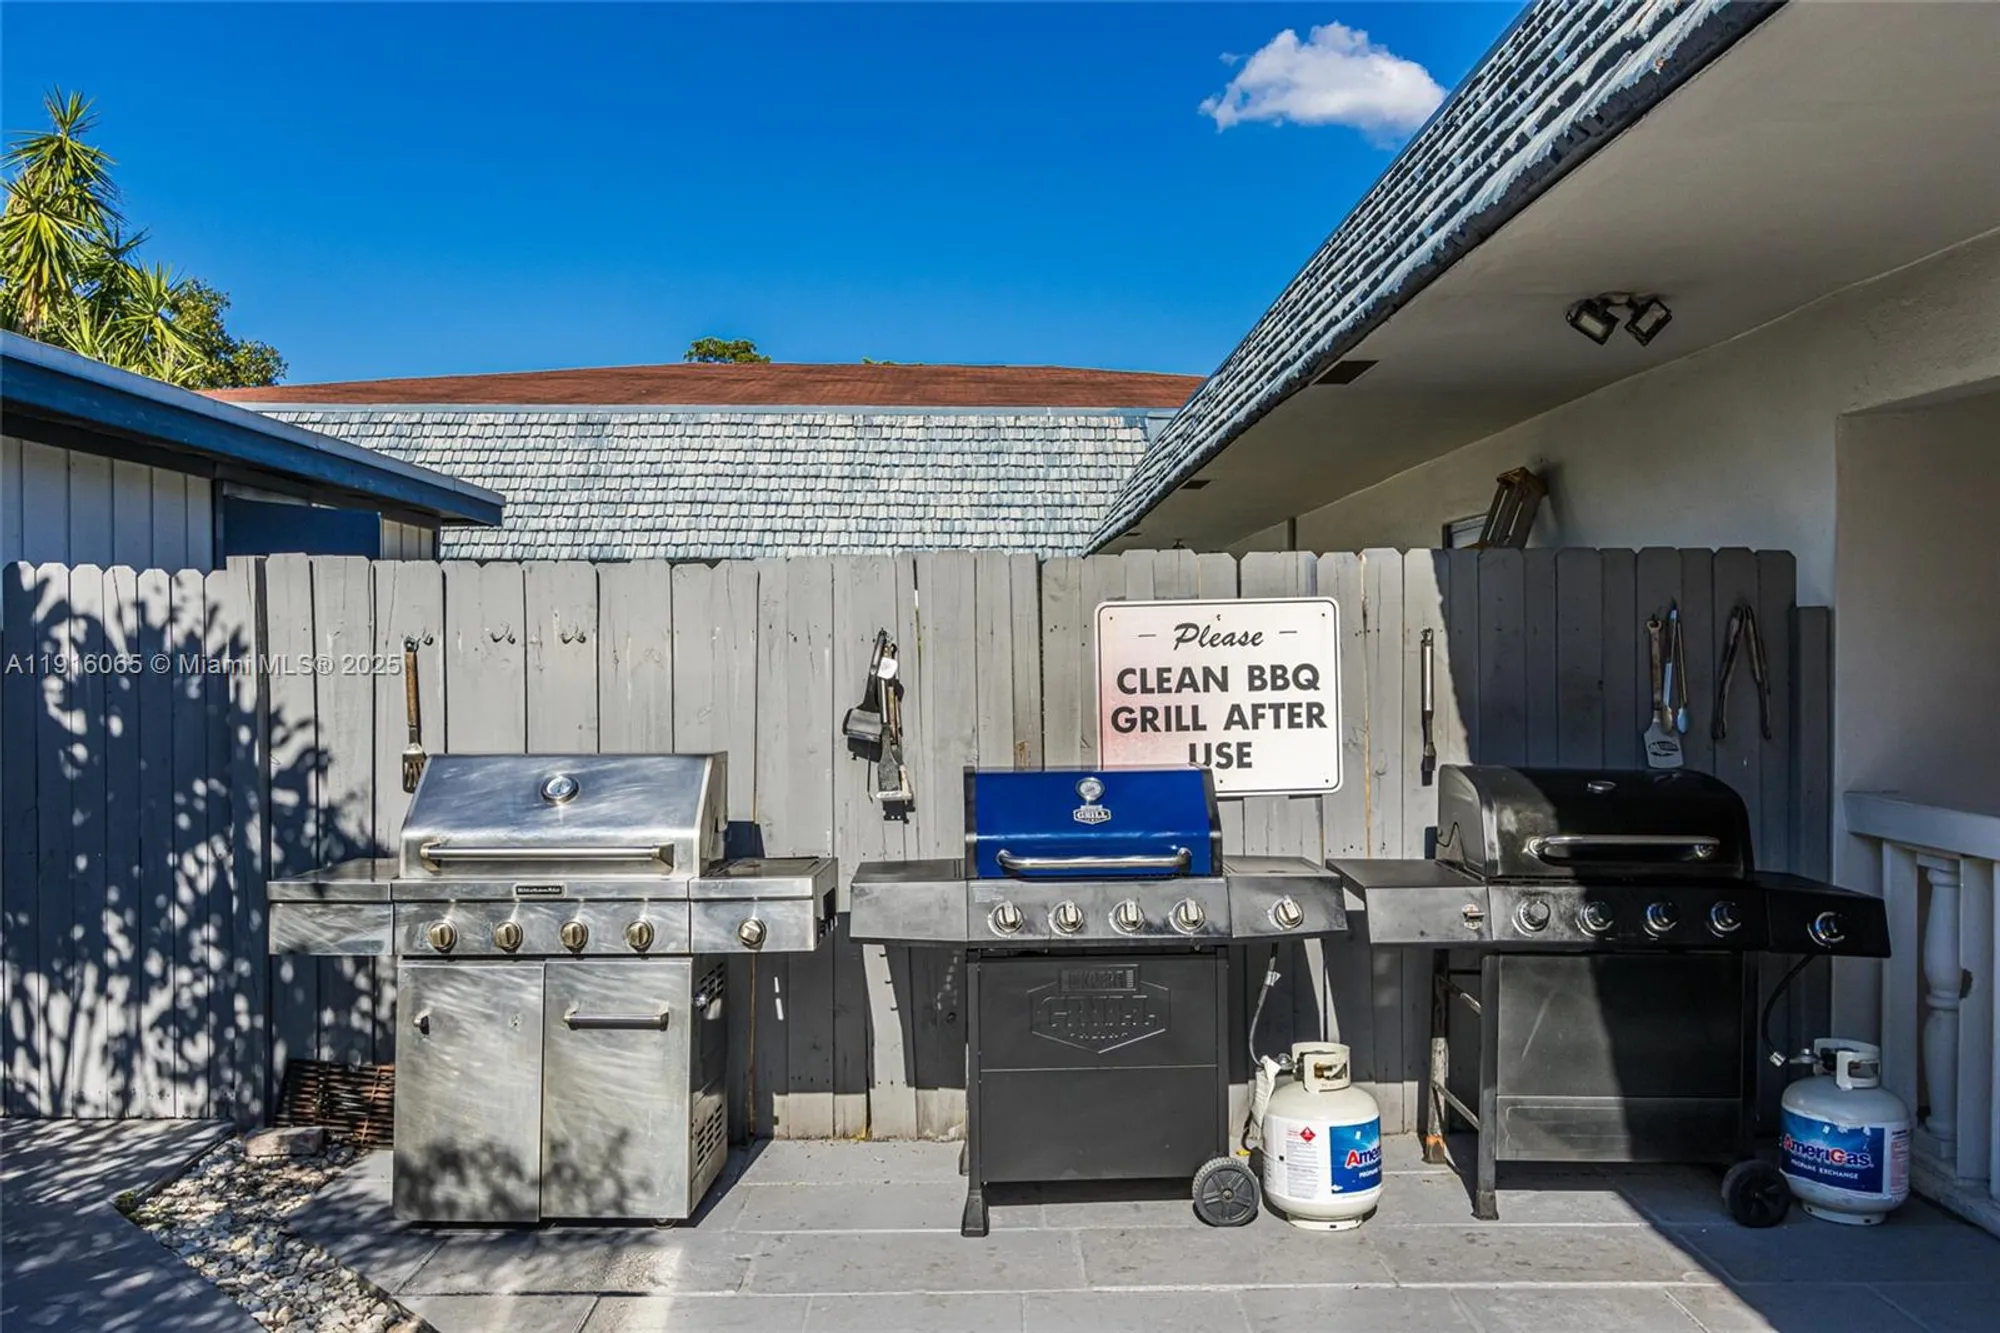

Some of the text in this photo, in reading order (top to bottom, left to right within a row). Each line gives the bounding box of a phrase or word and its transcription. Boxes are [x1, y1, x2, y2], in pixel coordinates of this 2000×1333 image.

[1173, 622, 1263, 651] Please
[1117, 663, 1321, 695] CLEAN BBQ
[1111, 702, 1328, 734] GRILL AFTER
[1188, 741, 1253, 770] USE
[1784, 1133, 1871, 1167] AmeriGas
[1819, 1166, 1860, 1180] EXCHANGE
